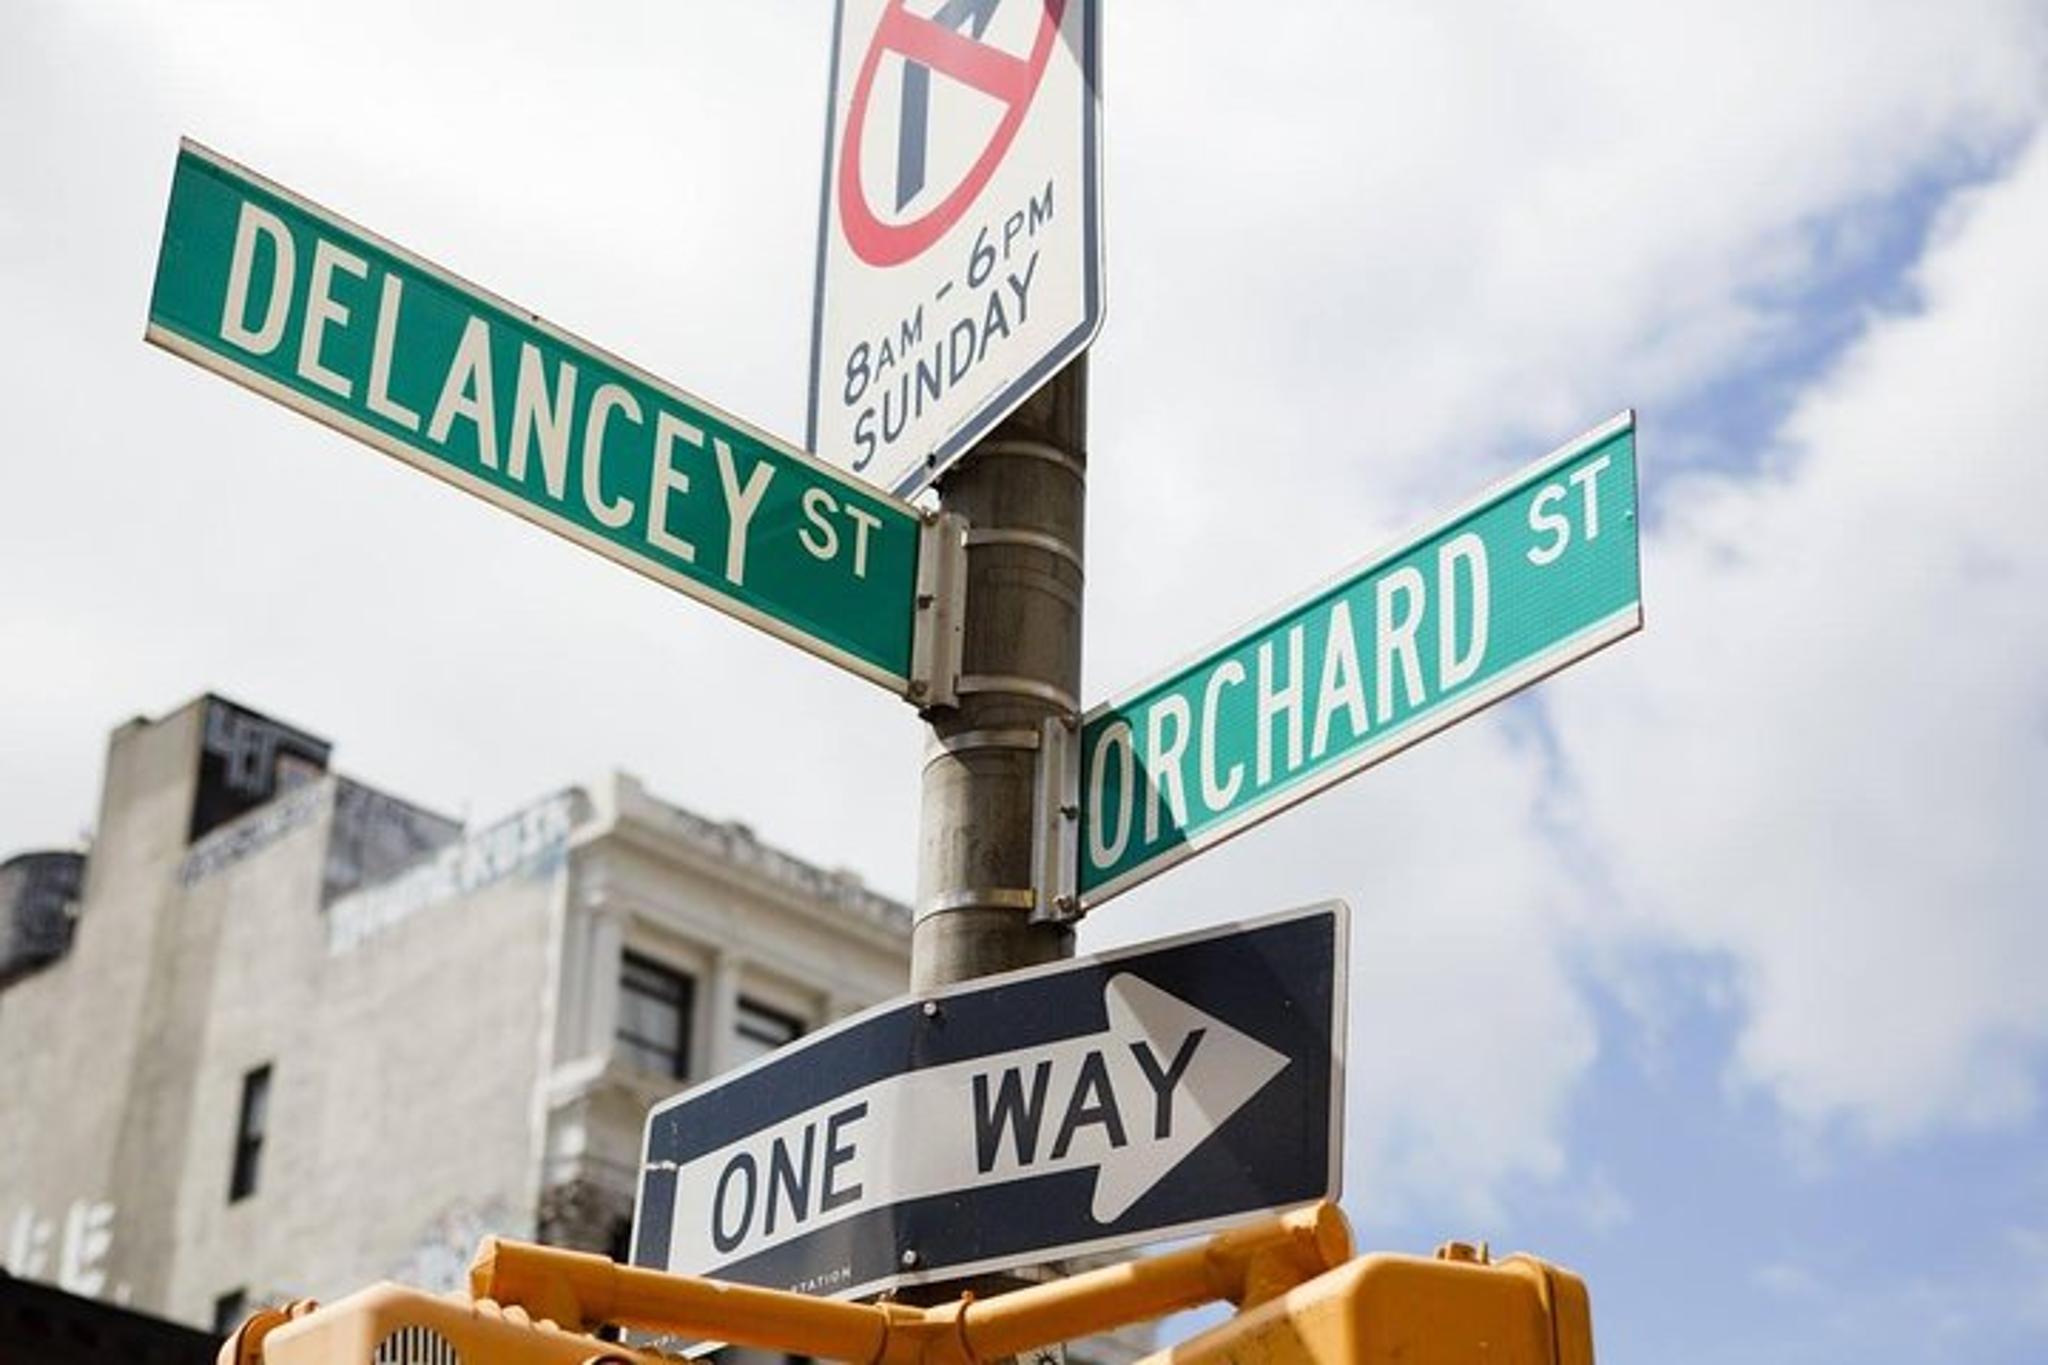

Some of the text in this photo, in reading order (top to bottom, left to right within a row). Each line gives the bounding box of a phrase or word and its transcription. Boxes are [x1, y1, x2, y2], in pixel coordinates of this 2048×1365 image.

[220, 201, 775, 586] DELANCEY
[798, 487, 882, 578] ST
[844, 181, 1054, 406] 8AM - 6PM
[852, 251, 1039, 473] SUNDAY
[1088, 456, 1611, 868] ORCHARD ST
[713, 1028, 1207, 1254] ONE WAY
